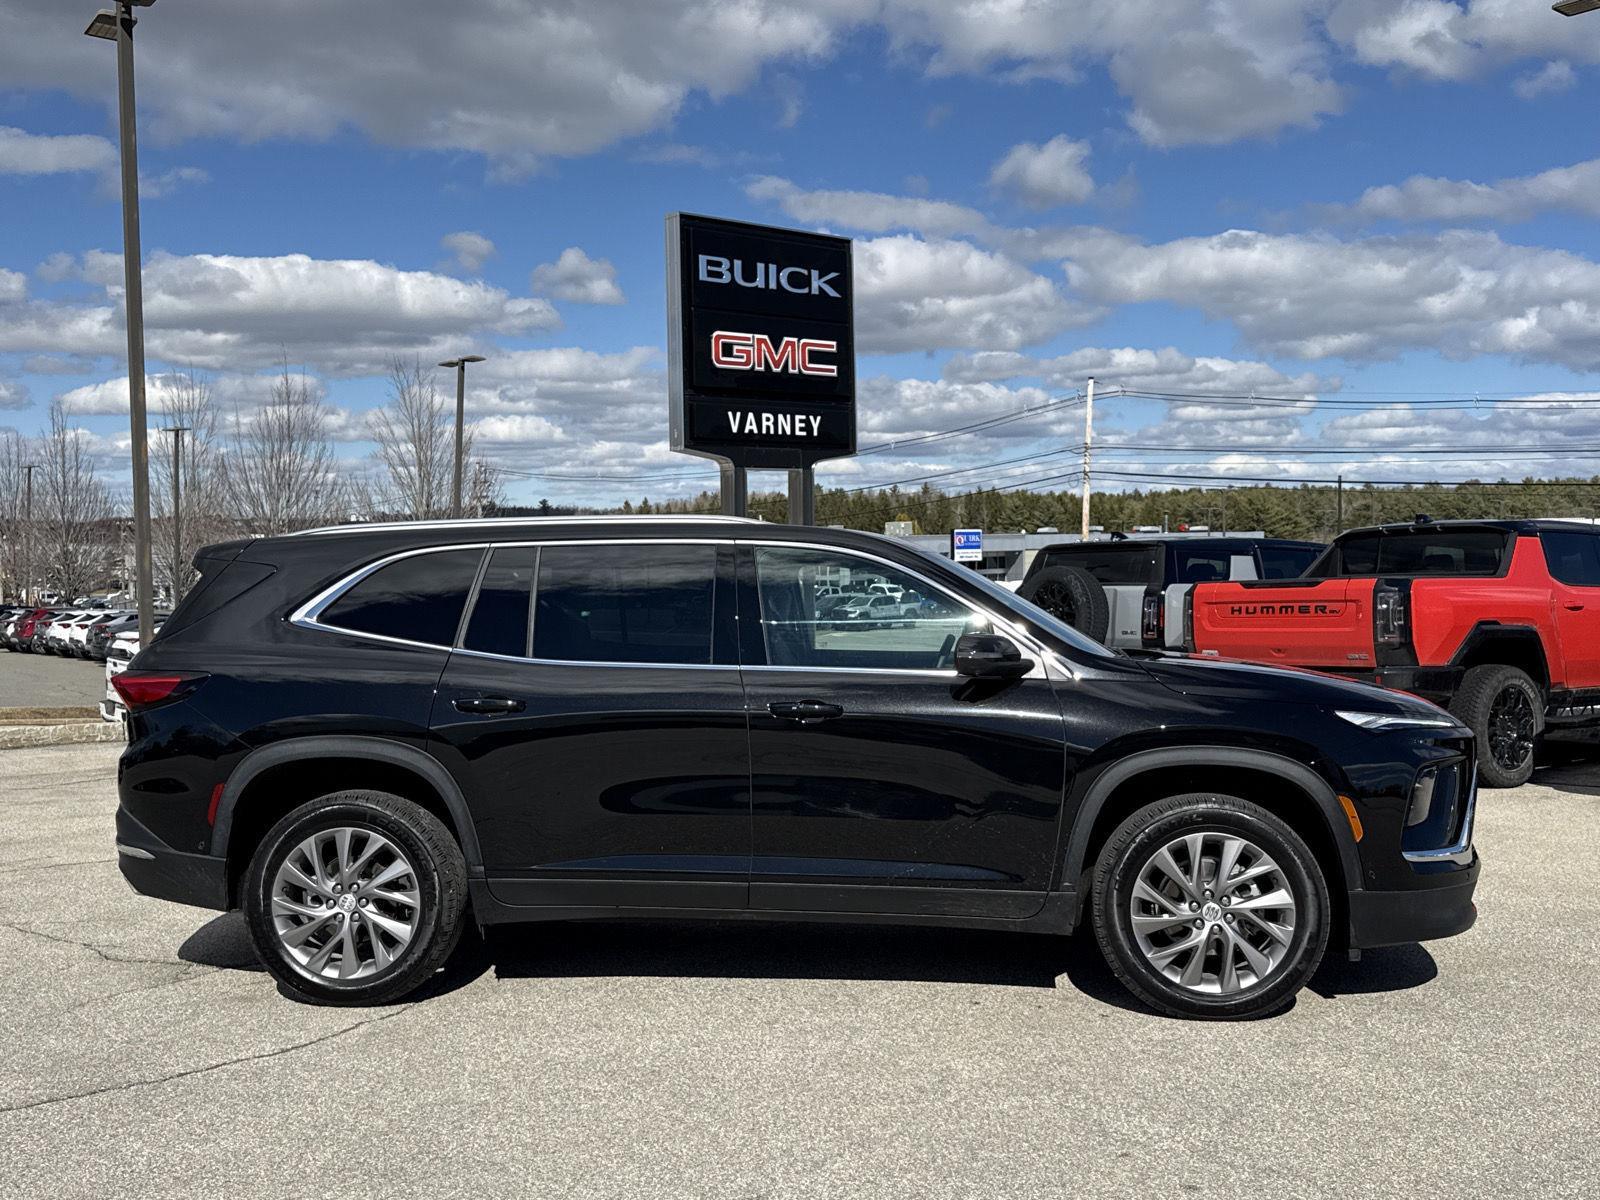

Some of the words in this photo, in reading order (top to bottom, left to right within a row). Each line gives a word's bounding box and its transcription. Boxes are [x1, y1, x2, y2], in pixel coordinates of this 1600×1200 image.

[698, 254, 842, 298] BUICK
[712, 330, 838, 377] GMC
[728, 411, 822, 437] VARNEY
[1231, 605, 1327, 615] HUMMER
